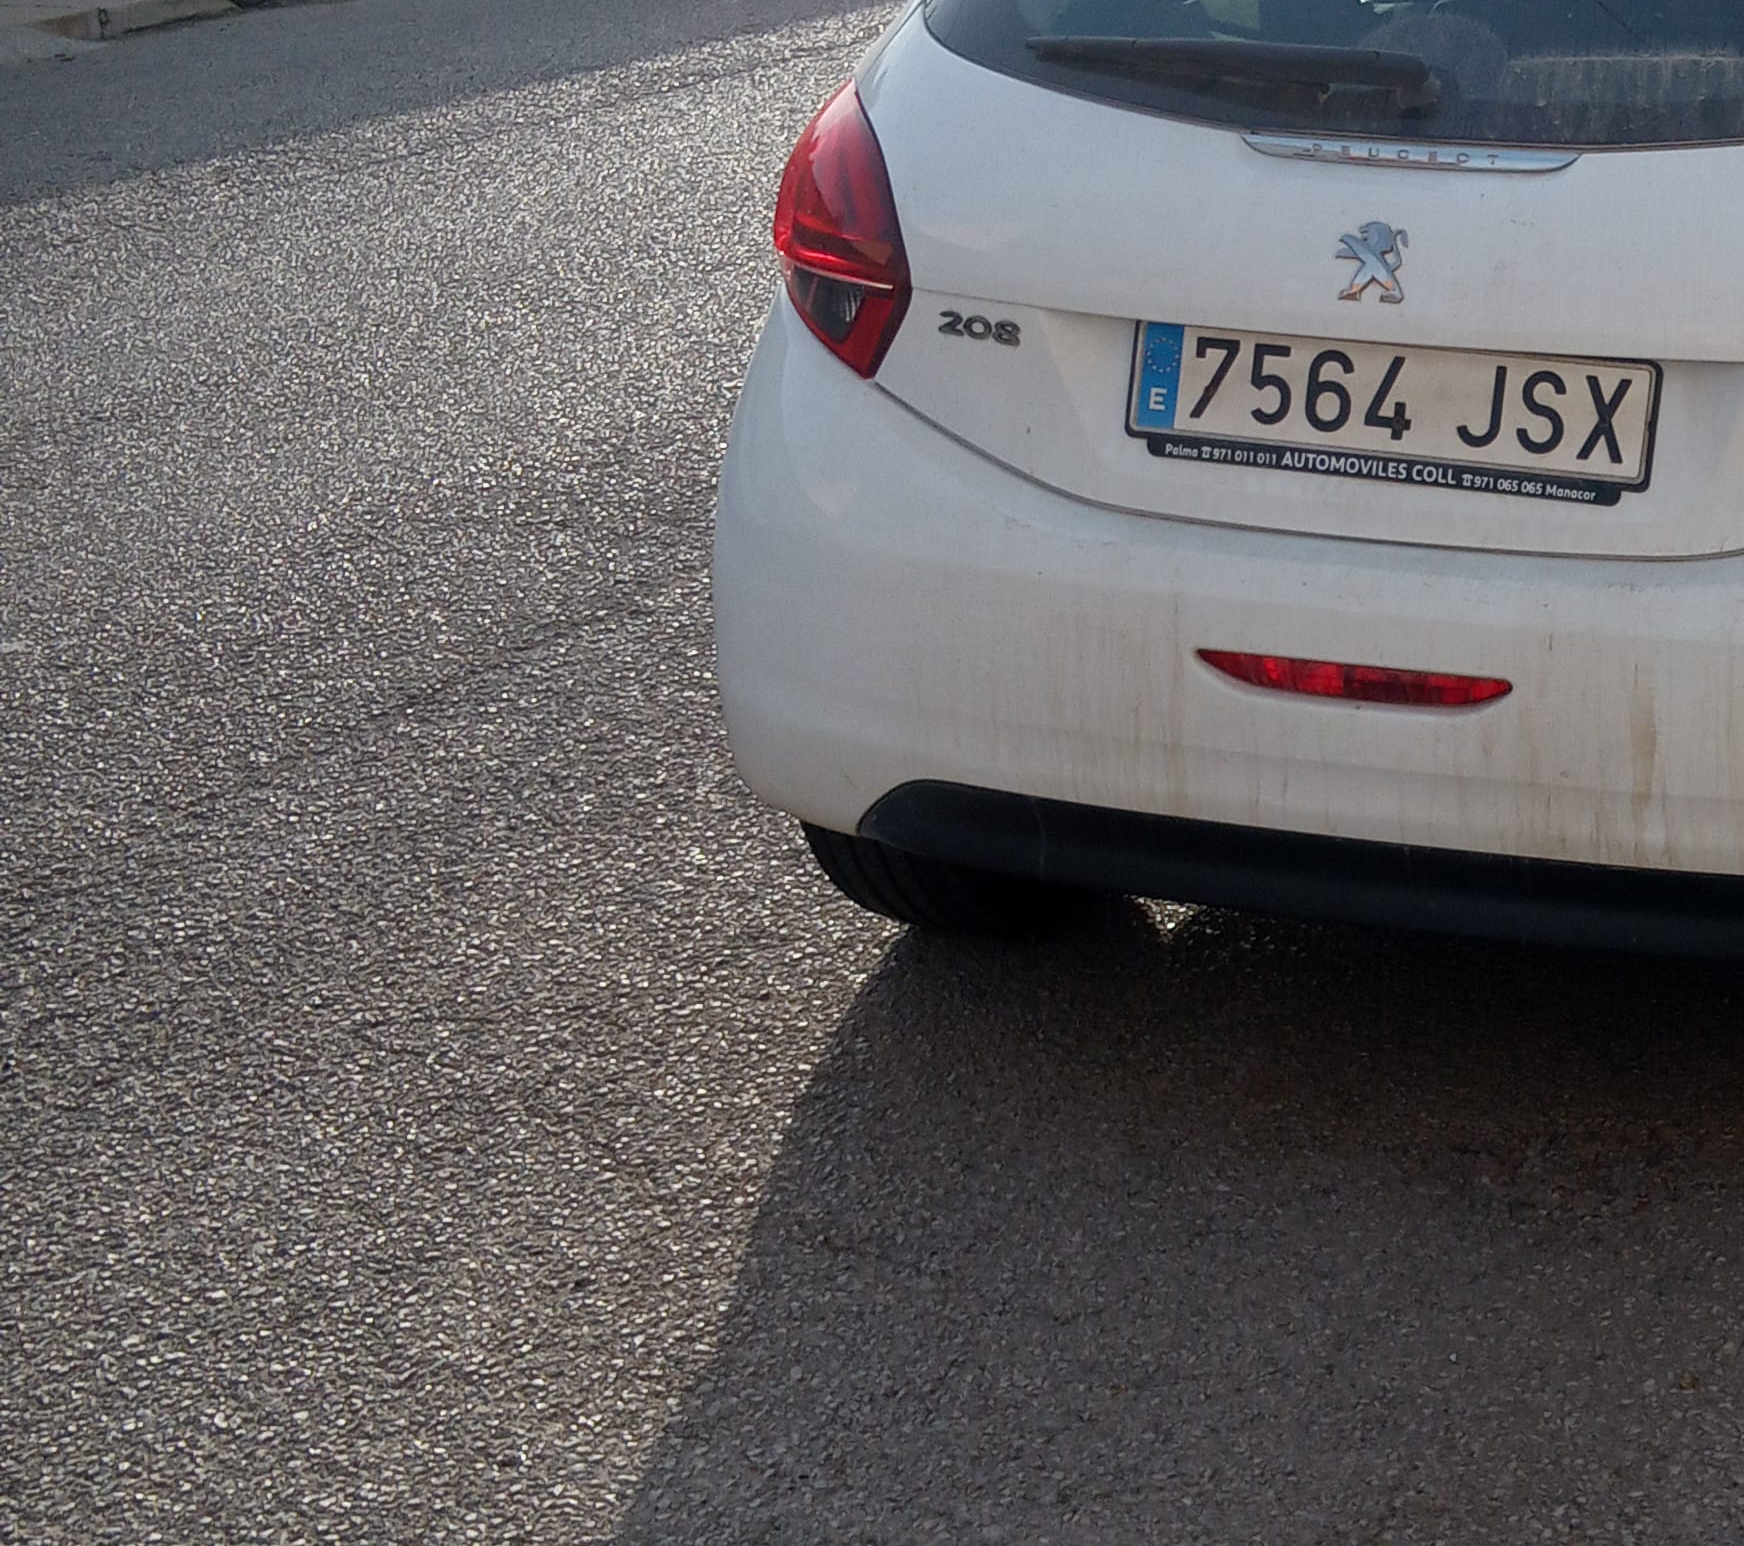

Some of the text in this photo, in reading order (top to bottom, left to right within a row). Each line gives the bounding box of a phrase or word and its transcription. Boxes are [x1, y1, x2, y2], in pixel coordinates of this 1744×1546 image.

[1309, 143, 1499, 166] PEUGEOT
[938, 310, 1021, 347] 208
[1148, 387, 1167, 410] E
[1190, 336, 1633, 465] 7564 JSX
[1164, 443, 1597, 502] Palma 971 011 011 AUTOMOVILES COLL 971 065 065 Manacor
